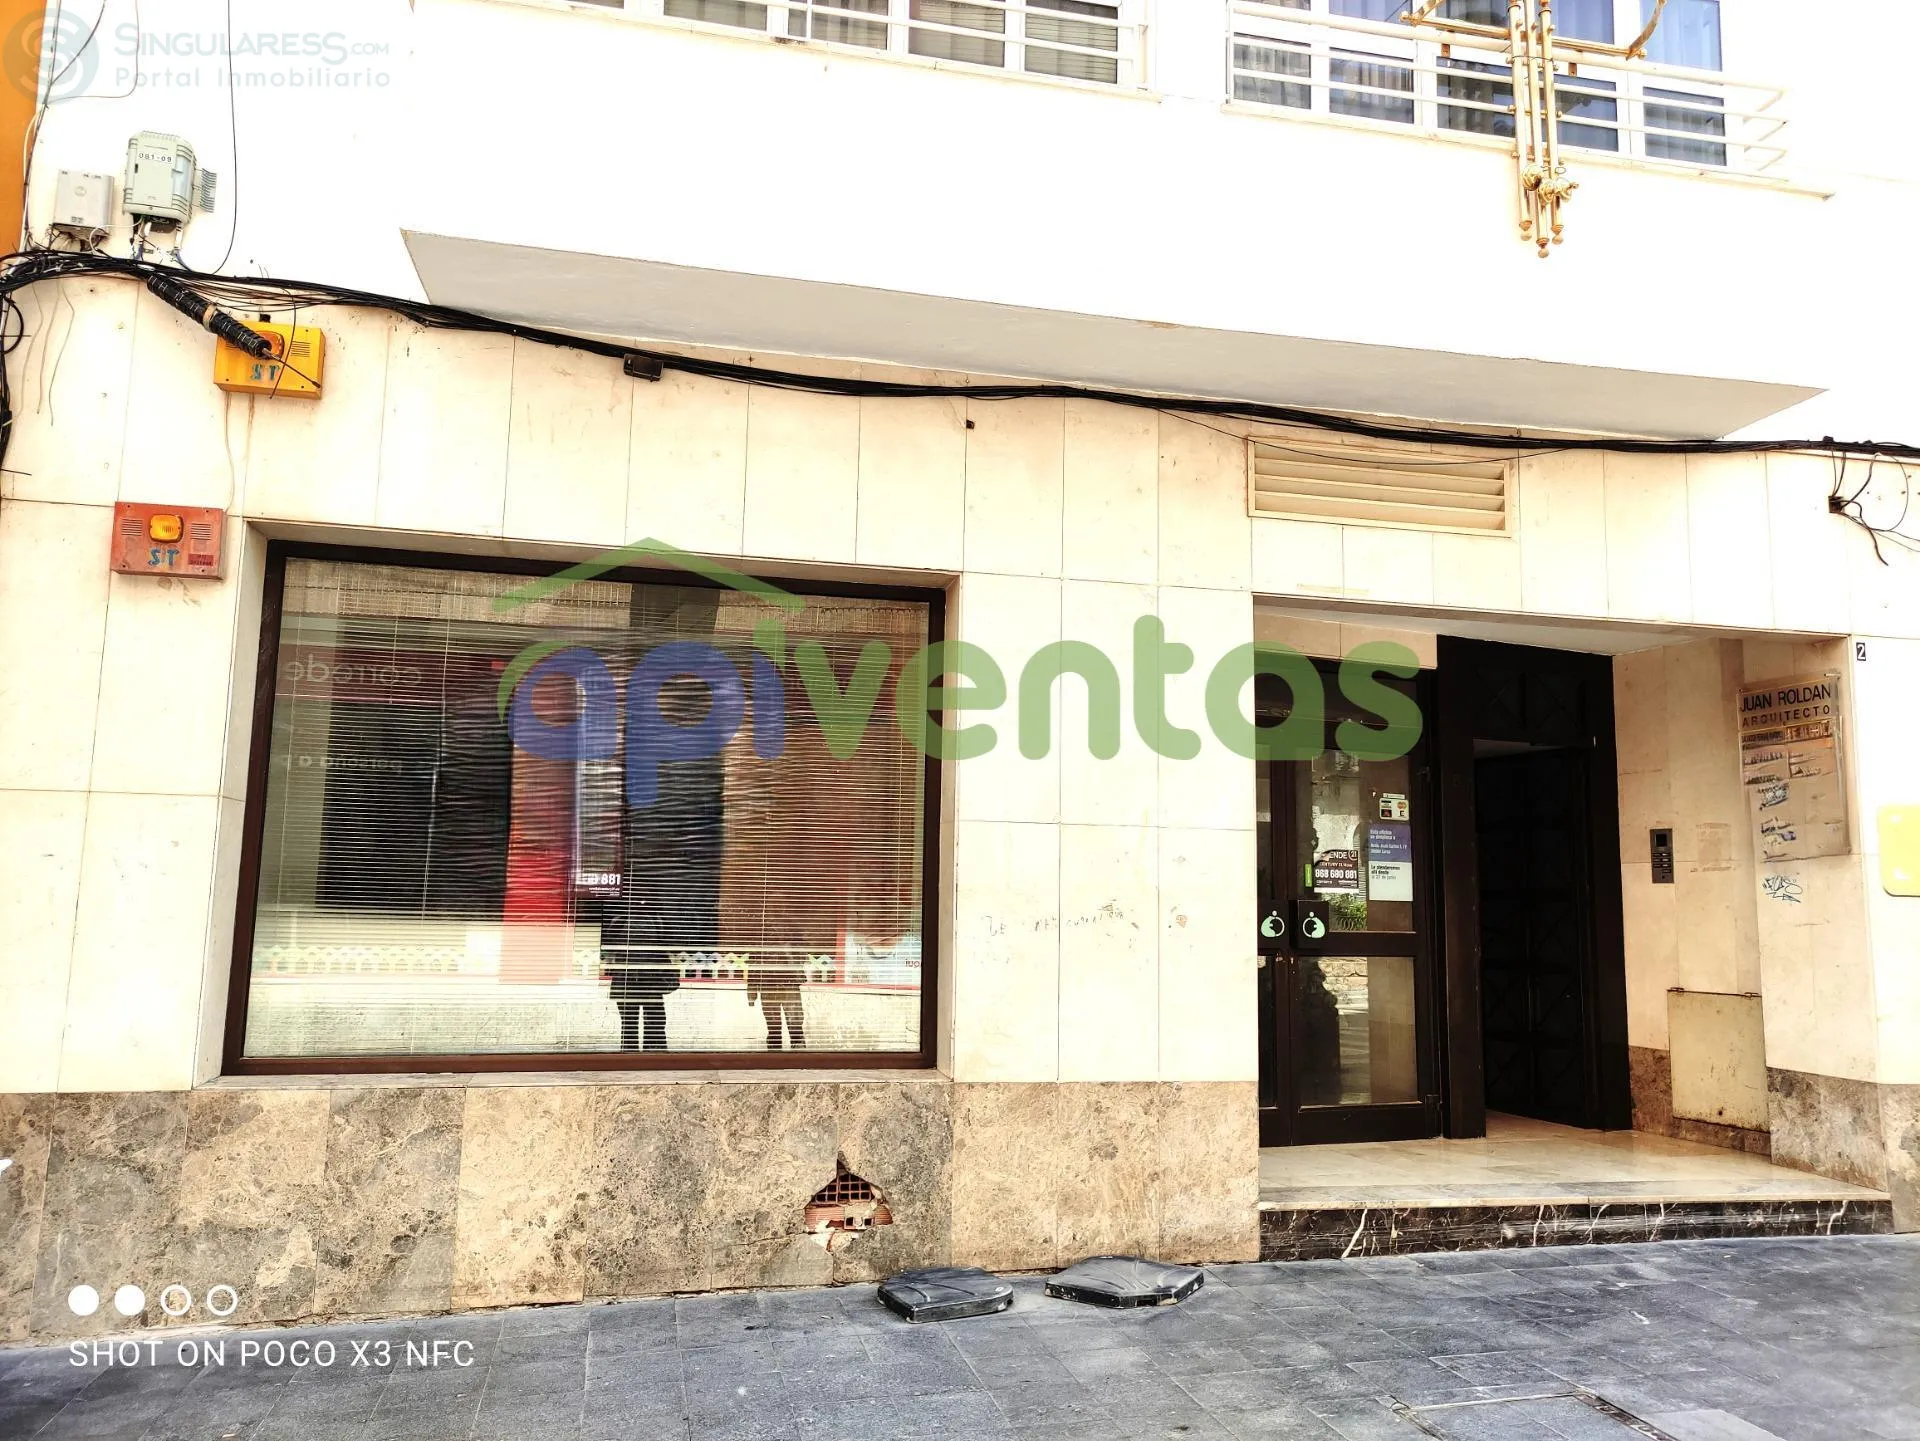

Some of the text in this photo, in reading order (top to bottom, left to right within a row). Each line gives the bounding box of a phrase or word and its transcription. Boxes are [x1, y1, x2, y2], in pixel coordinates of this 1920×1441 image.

[1856, 642, 1867, 662] 2
[1740, 682, 1833, 713] JUAN ROLDAN
[1742, 704, 1831, 728] ARQUITECTO
